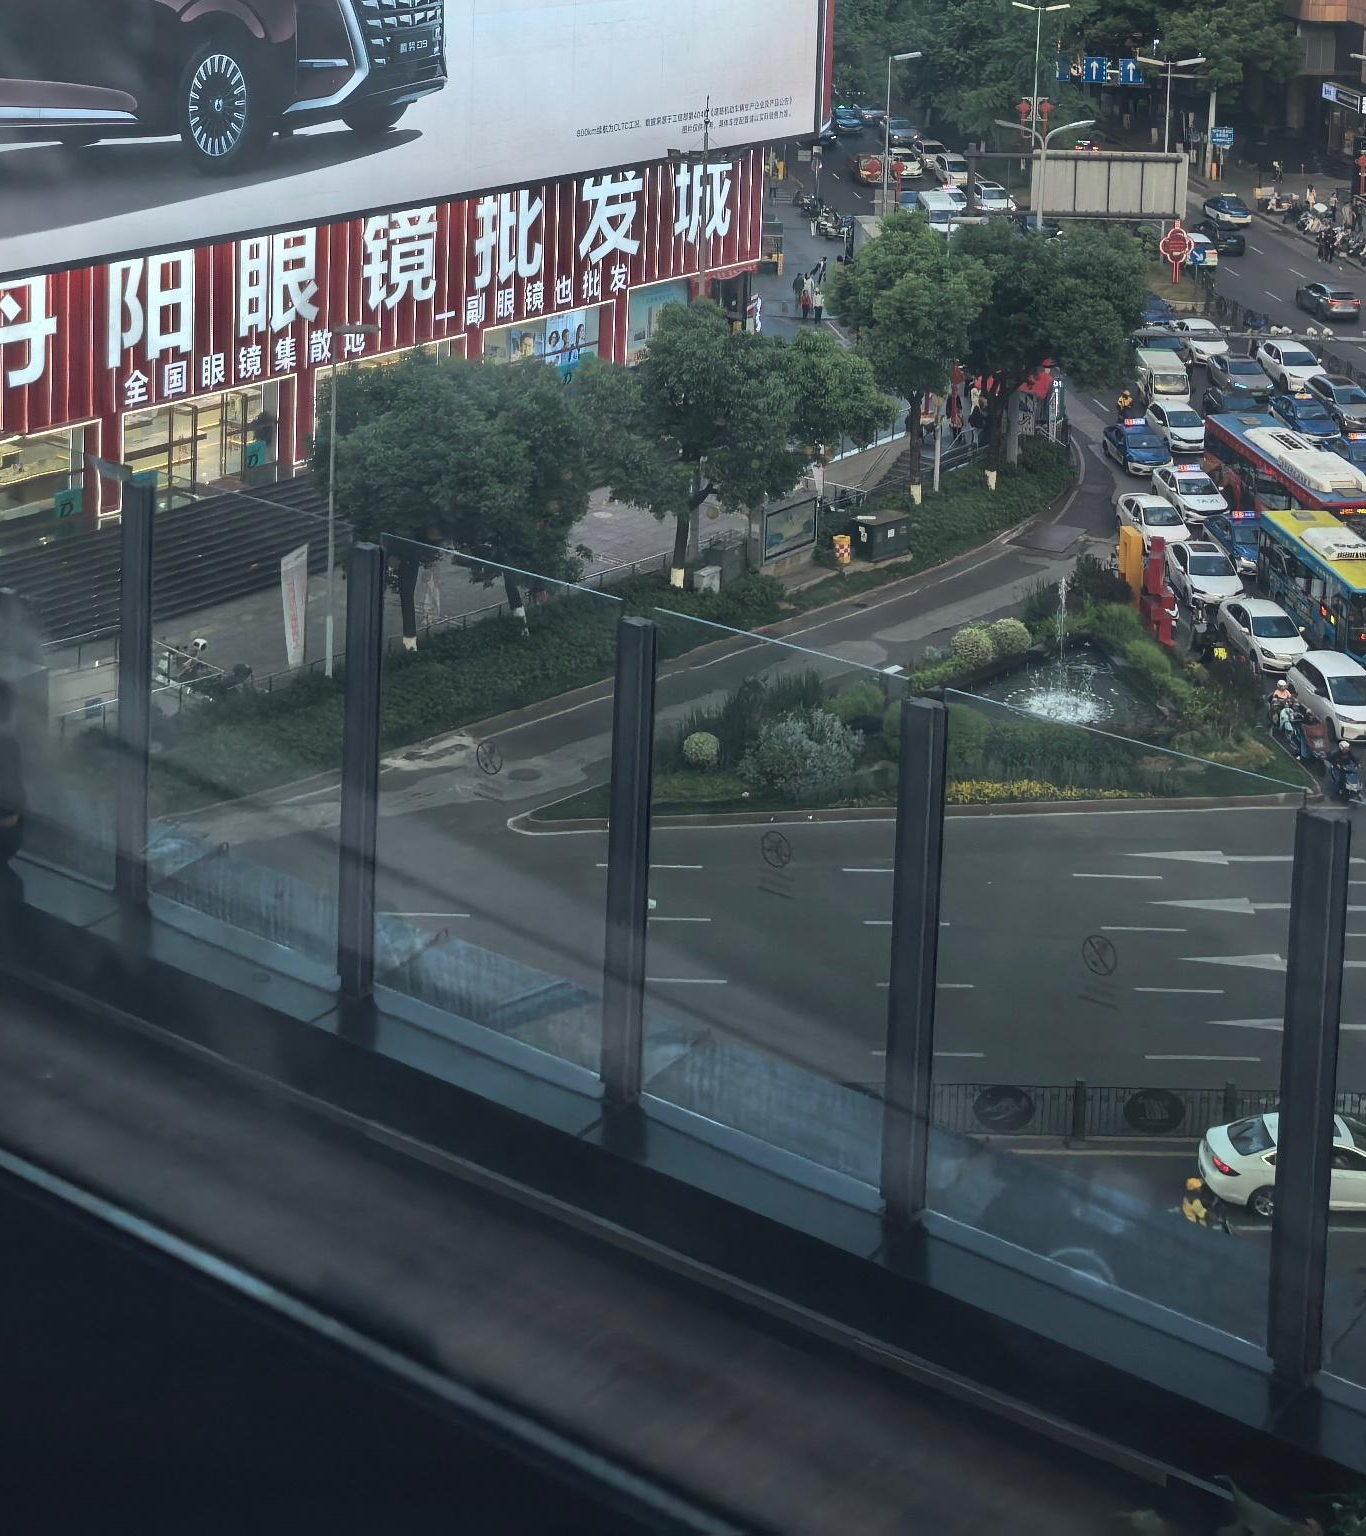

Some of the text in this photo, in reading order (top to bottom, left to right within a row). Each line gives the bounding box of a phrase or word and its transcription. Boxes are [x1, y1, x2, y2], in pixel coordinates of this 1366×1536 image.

[434, 263, 629, 326] 一副眼镜也批发
[123, 327, 366, 405] 全国眼镜集散地
